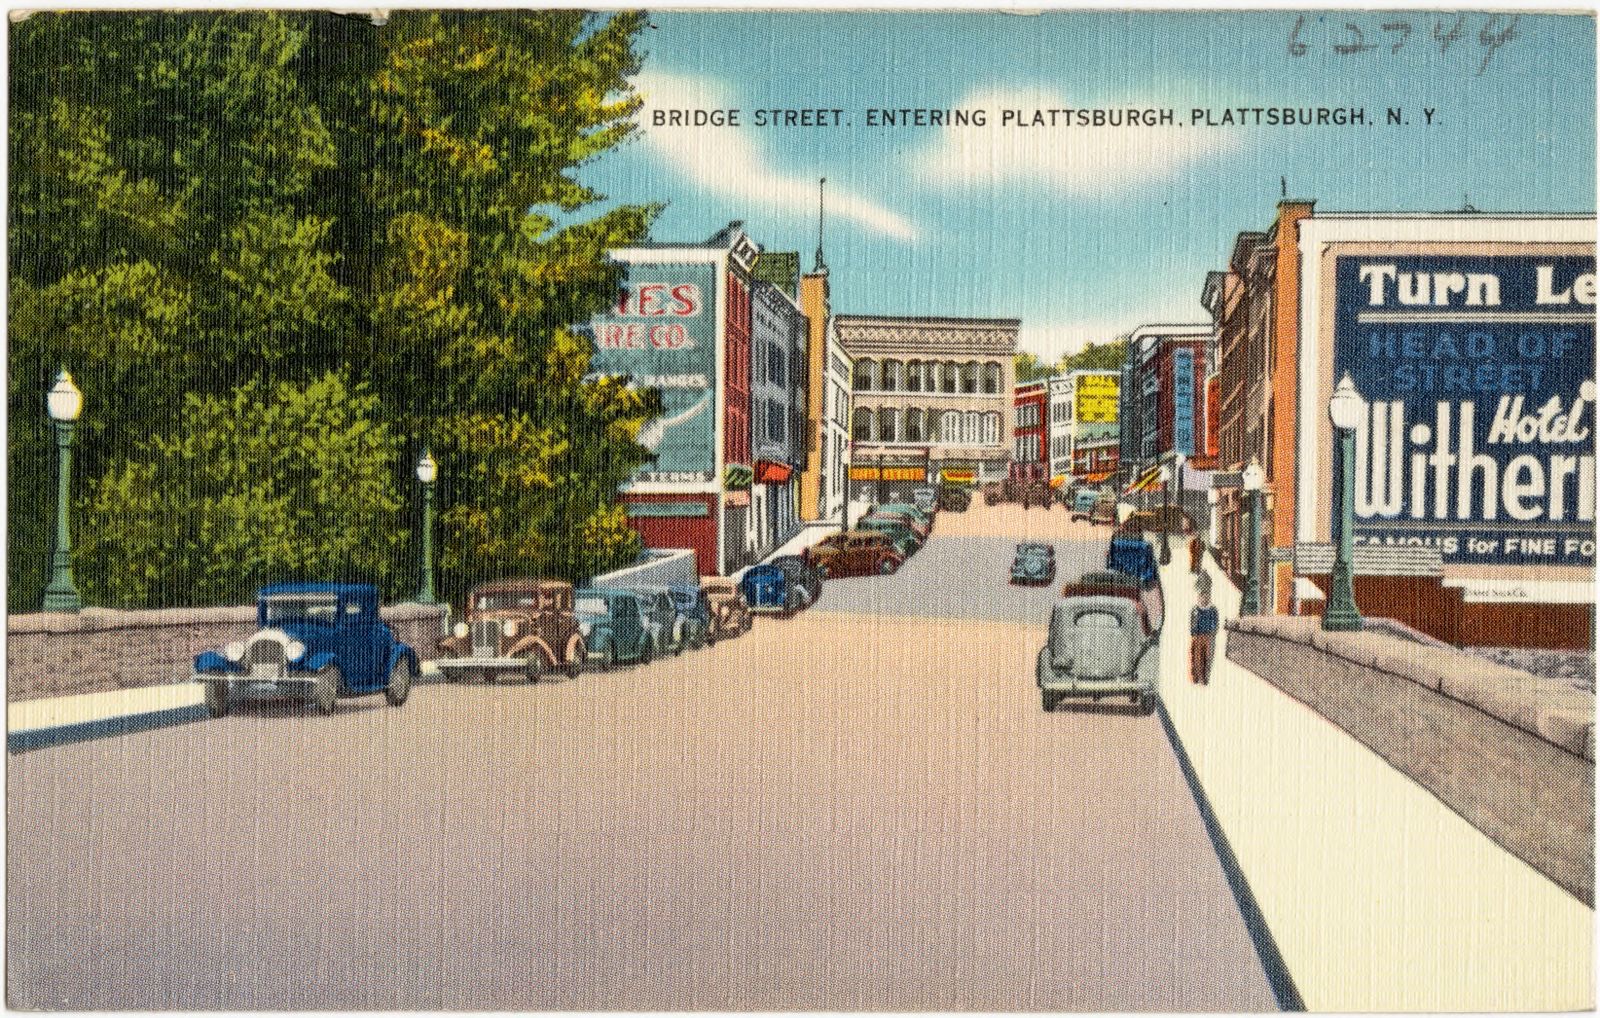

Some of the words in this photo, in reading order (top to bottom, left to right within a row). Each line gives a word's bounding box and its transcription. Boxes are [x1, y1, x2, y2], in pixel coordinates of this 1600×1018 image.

[1359, 264, 1501, 305] Turn
[1368, 331, 1498, 358] HEAD
[1517, 331, 1578, 358] OF
[1395, 364, 1544, 392] STREET
[1488, 395, 1588, 443] Hotel
[1467, 539, 1499, 553] for
[1504, 539, 1556, 555] FINE
